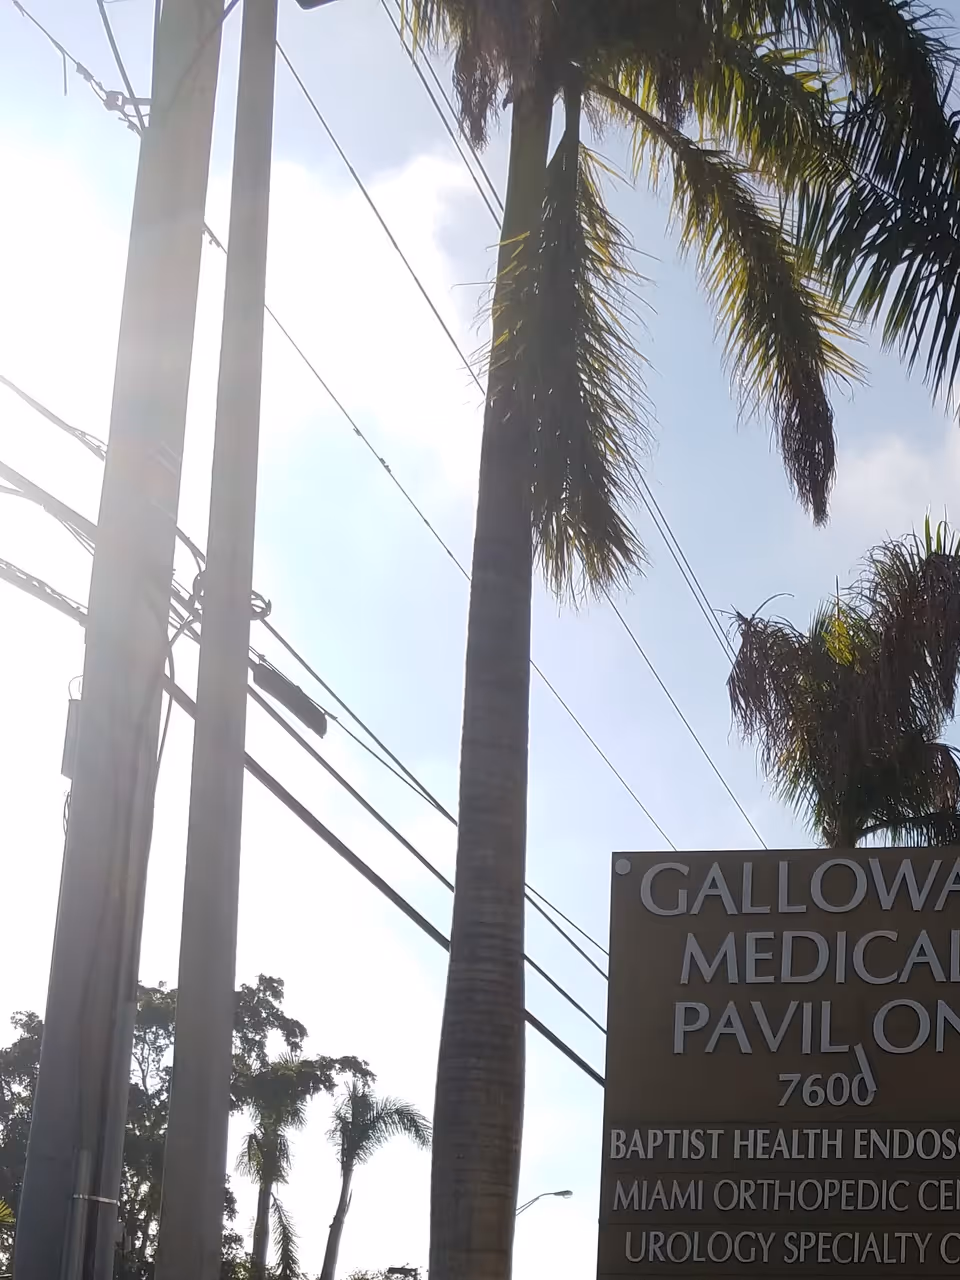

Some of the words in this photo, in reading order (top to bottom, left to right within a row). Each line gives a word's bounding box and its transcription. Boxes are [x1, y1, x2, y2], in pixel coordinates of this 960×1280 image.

[777, 1072, 876, 1107] 7600
[610, 1129, 724, 1160] BAPTIST
[733, 1129, 843, 1159] HEALTH
[612, 1179, 704, 1211] MIAMI
[713, 1179, 910, 1212] ORTHOPEDIC
[625, 1231, 776, 1263] UROLOGY
[783, 1231, 933, 1264] SPECIALTY
